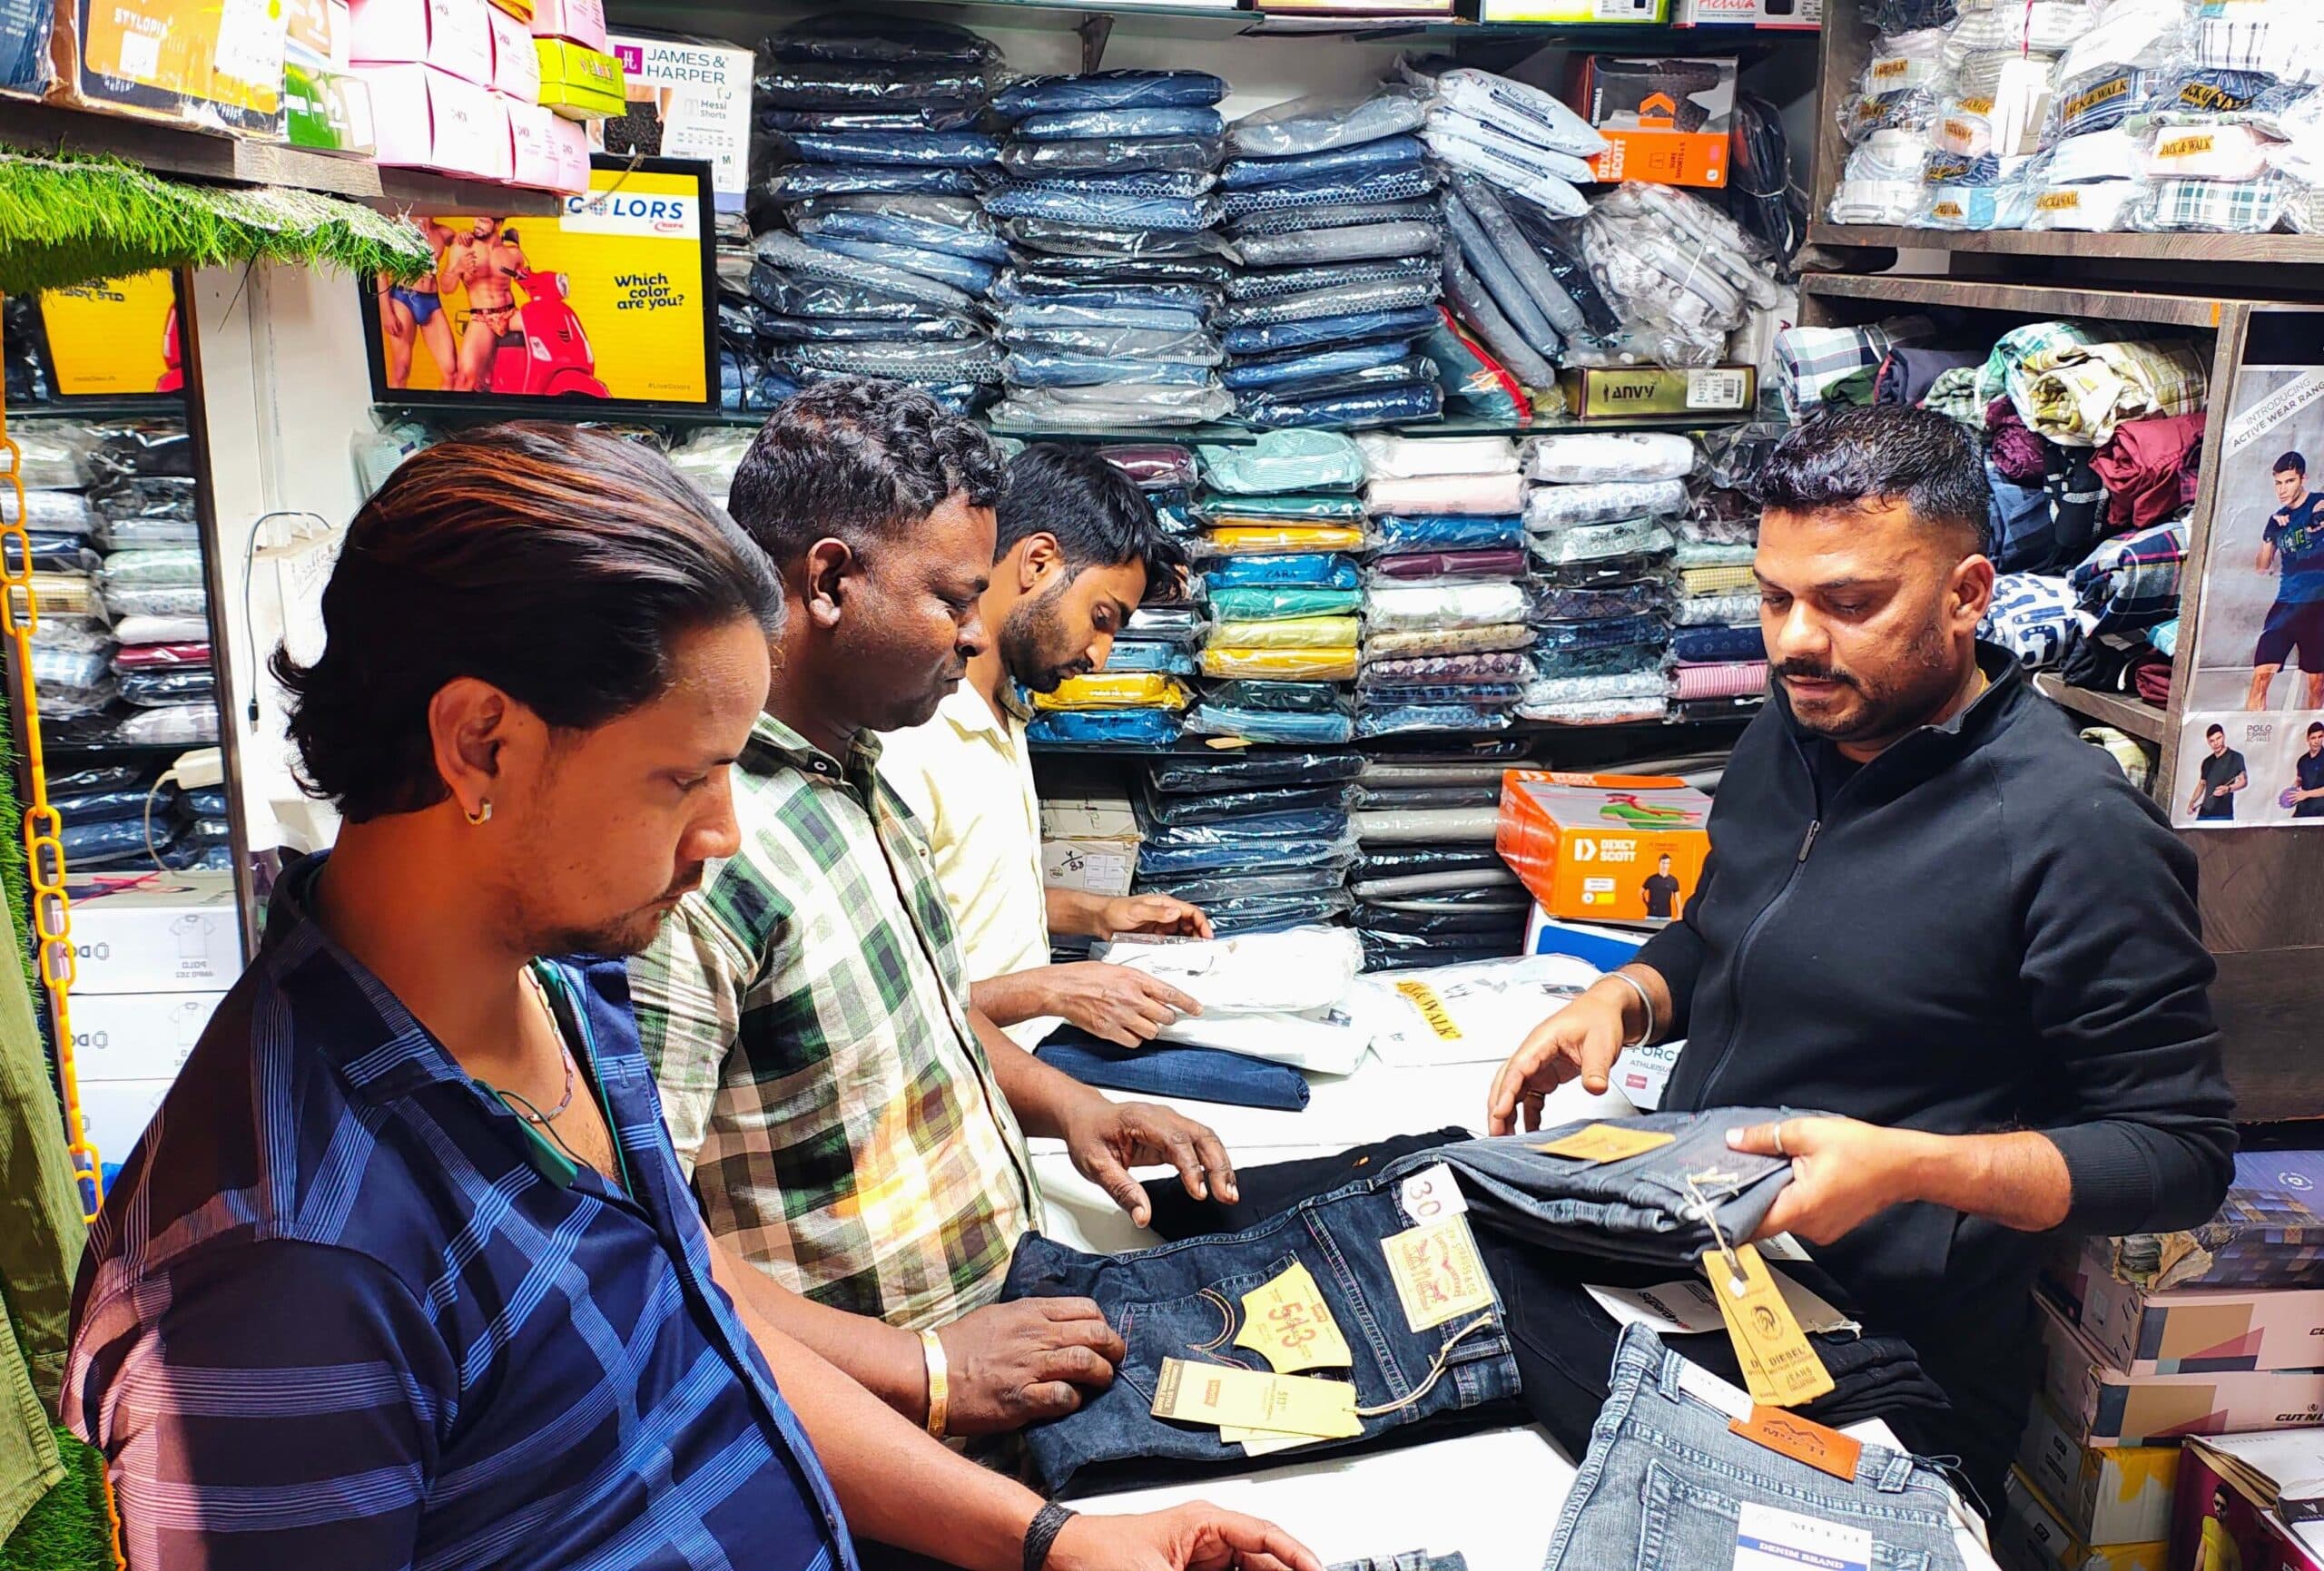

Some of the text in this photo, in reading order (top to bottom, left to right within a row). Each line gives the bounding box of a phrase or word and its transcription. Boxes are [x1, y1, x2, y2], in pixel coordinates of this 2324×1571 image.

[114, 7, 169, 38] STYLOPIA
[647, 48, 725, 68] JAMES &
[647, 64, 725, 84] HARPER
[2188, 138, 2211, 152] WALK
[1610, 139, 1626, 179] SCOTT
[615, 273, 668, 287] Which
[617, 294, 684, 310] are you?
[629, 285, 671, 299] color
[2246, 378, 2310, 425] INTRODUCING
[2233, 420, 2267, 447] ACTIVE
[2267, 400, 2297, 423] WEAR
[1600, 840, 1637, 851] DIXCY
[1600, 850, 1637, 861] SCOTT
[1409, 1181, 1442, 1217] 30
[1267, 1301, 1316, 1348] 513
[1769, 1346, 1806, 1368] DIESEL
[1759, 1542, 1845, 1568] DENIM BRAND
